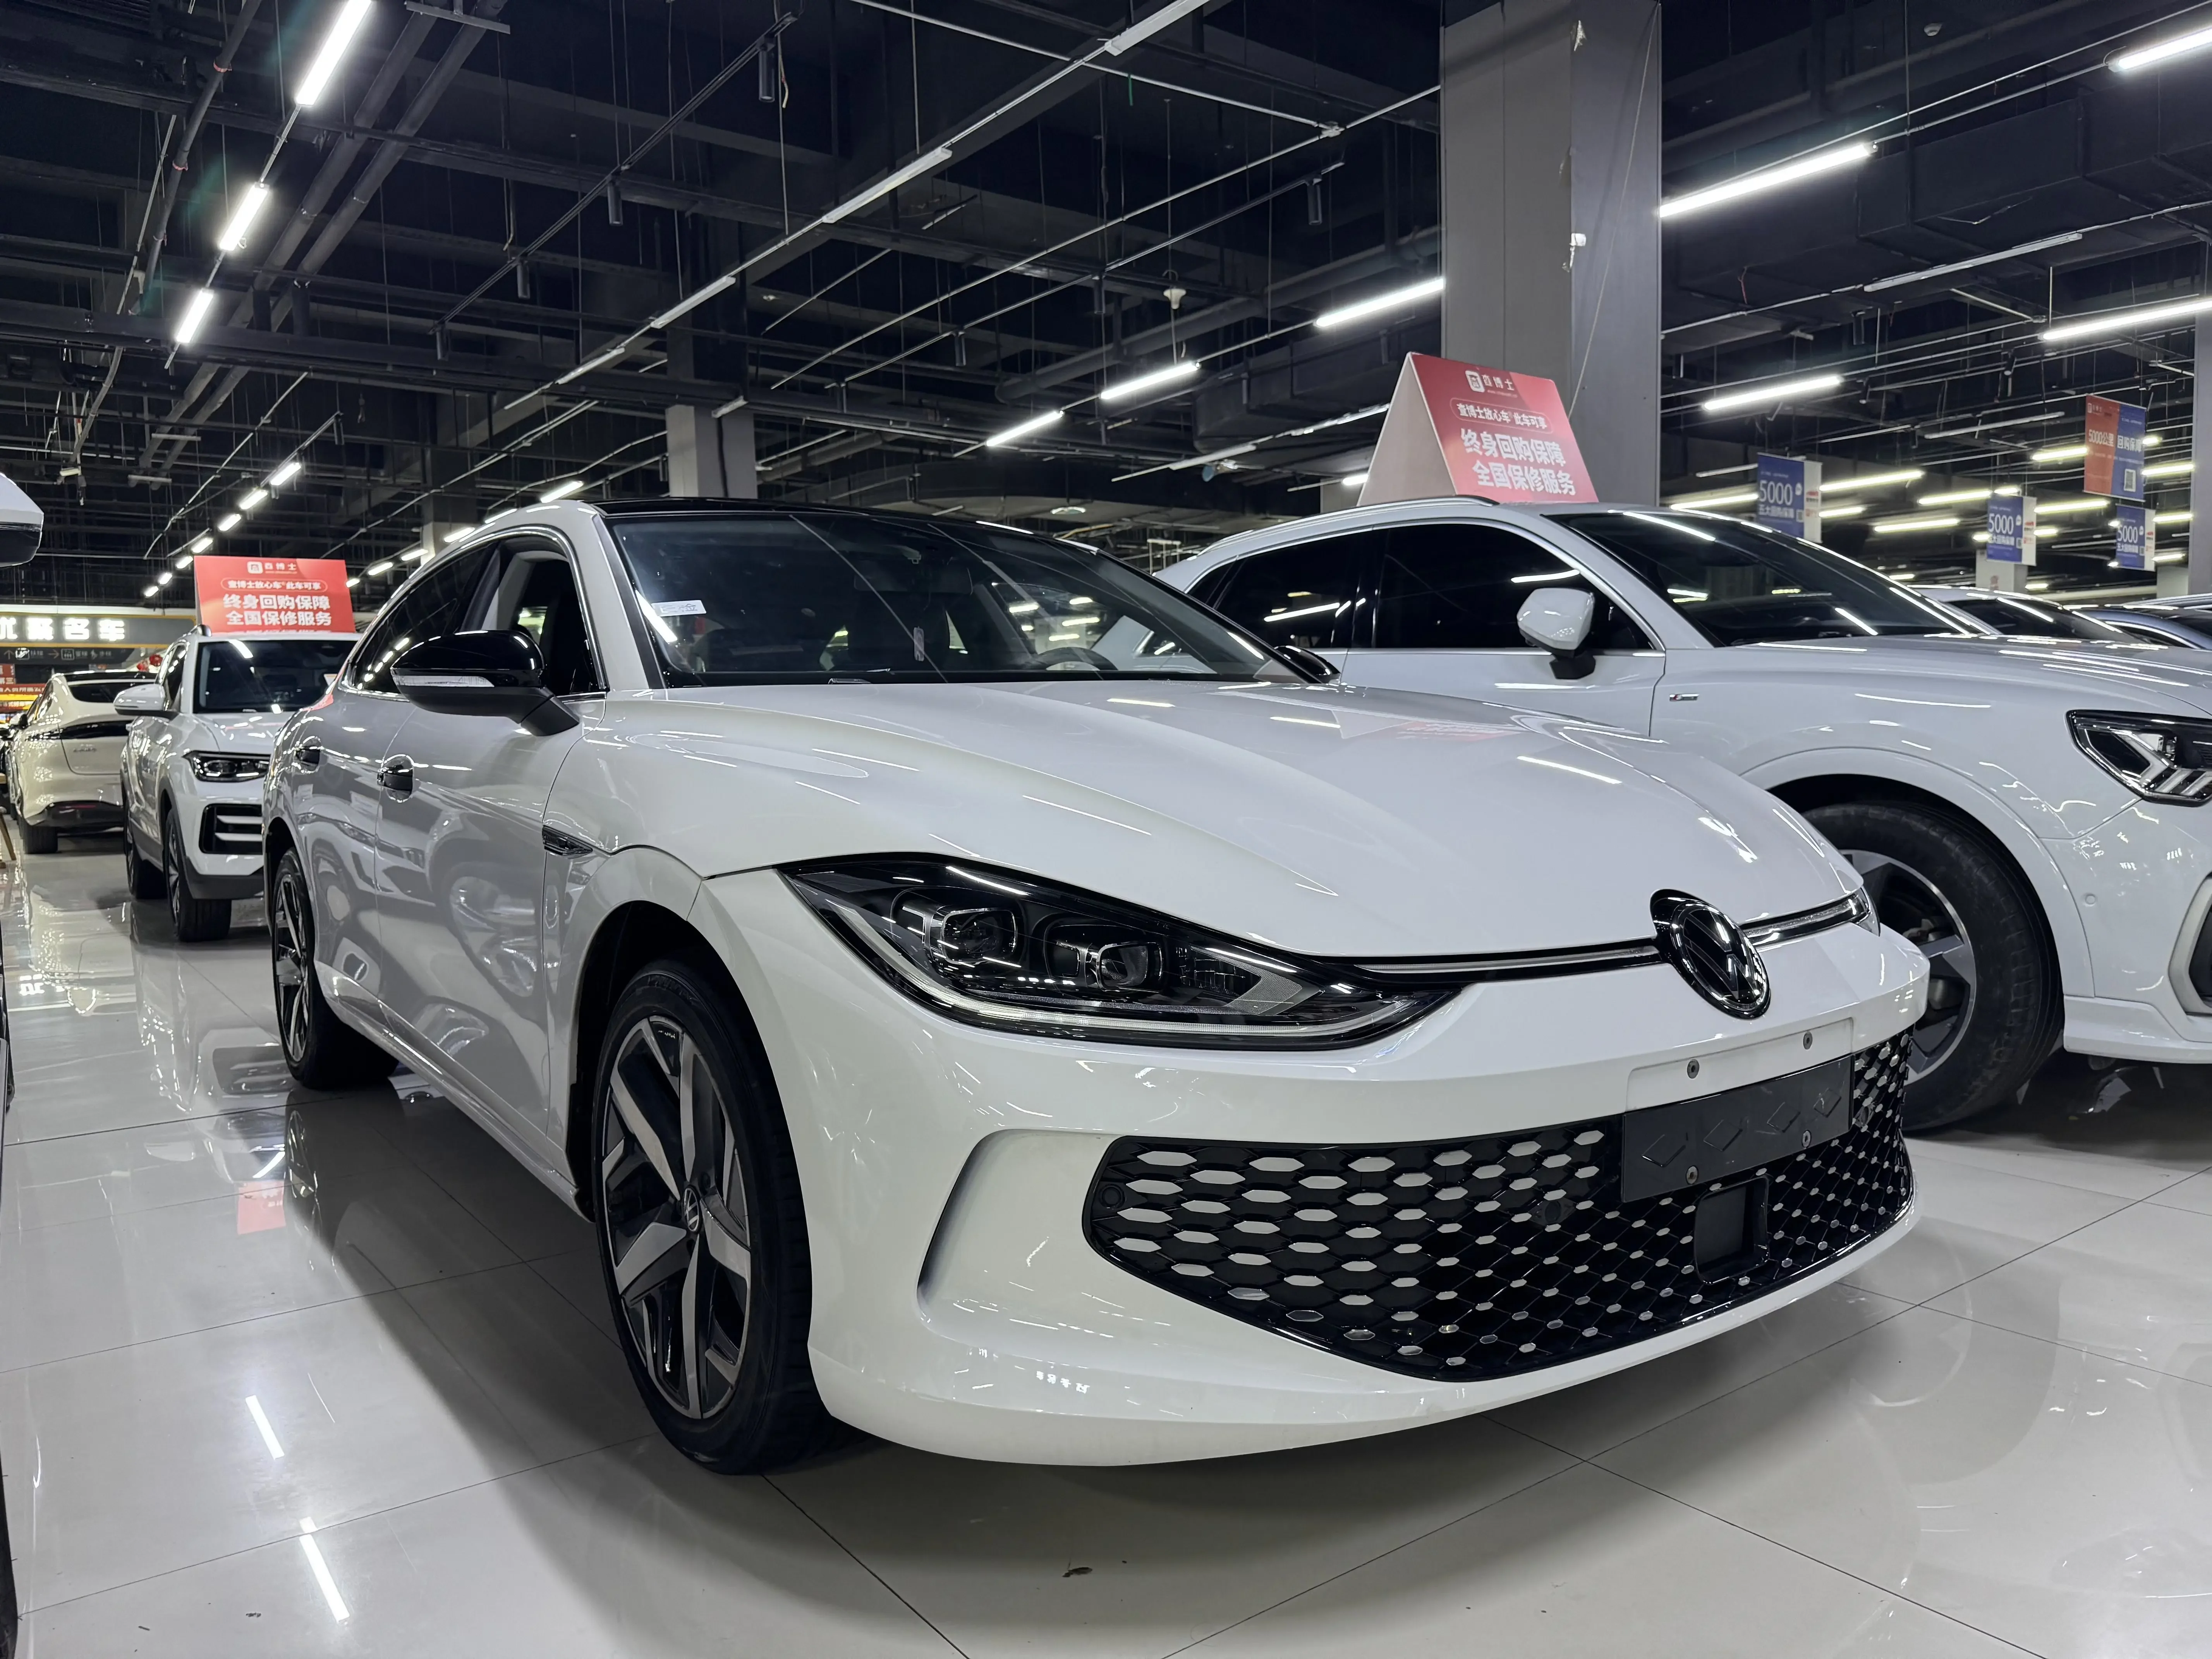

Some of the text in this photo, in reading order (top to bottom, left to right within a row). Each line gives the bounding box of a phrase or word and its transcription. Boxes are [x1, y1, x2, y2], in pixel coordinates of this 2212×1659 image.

[1482, 374, 1515, 391] 查博士
[1461, 428, 1566, 467] 终身回购保障
[2088, 429, 2142, 452] 5000公里 回购保障
[1472, 460, 1576, 496] 全国保修服务
[1760, 480, 1792, 505] 5000
[1989, 513, 2014, 535] 5000
[2117, 525, 2138, 543] 5000
[223, 594, 330, 610] 终身回购保障
[226, 611, 331, 626] 全国保修服务
